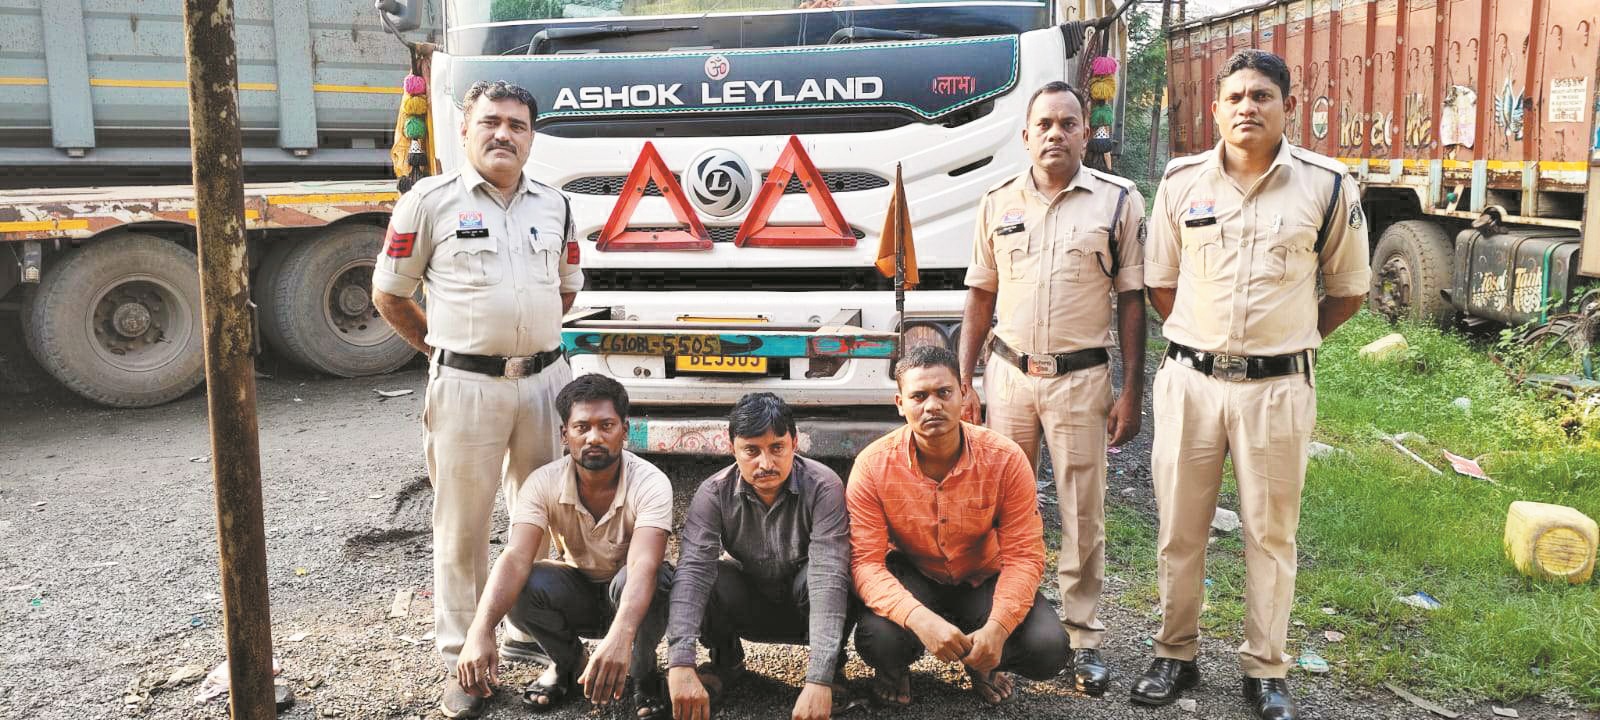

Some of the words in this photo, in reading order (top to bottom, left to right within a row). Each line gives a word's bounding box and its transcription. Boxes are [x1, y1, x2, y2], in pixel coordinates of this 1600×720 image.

[552, 83, 685, 110] ASHOK
[701, 76, 883, 104] LEYLAND
[709, 171, 730, 191] L
